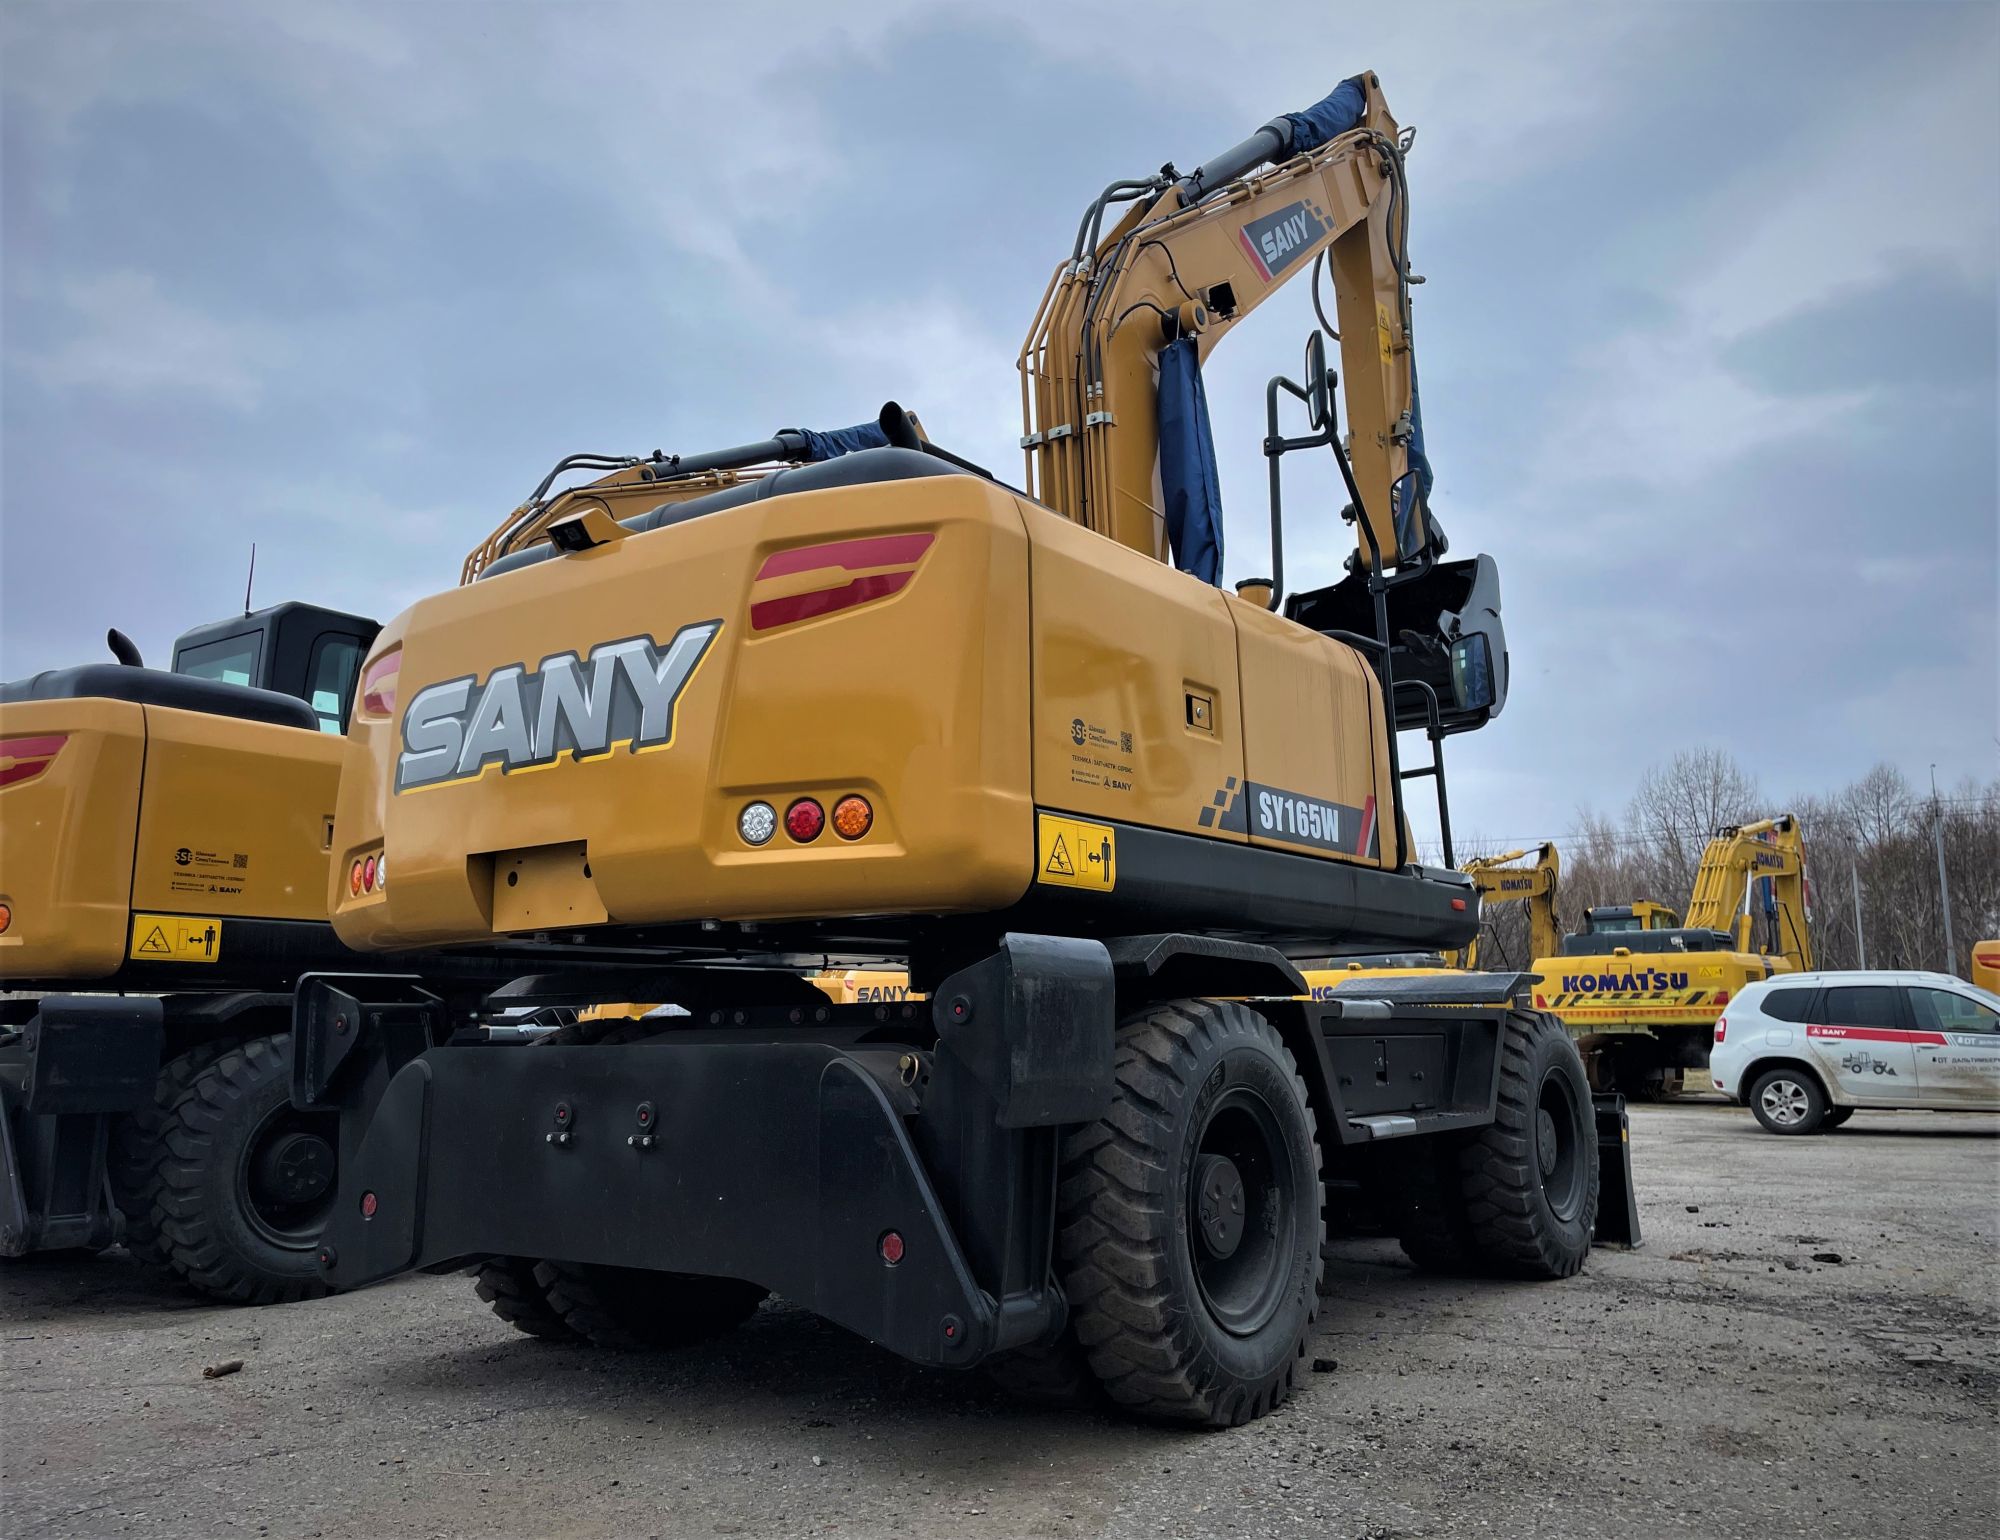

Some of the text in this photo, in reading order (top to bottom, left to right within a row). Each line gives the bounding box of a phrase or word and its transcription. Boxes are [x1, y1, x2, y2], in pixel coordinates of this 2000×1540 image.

[1261, 210, 1308, 264] SANY
[397, 620, 720, 790] SANY
[1072, 755, 1091, 764] ТЕХНИКА
[1112, 780, 1132, 791] SANY
[1259, 791, 1339, 843] SY165W
[1756, 850, 1784, 869] KOMATSU
[1501, 875, 1533, 891] KOMATSU
[1562, 968, 1688, 993] KOMATSU
[857, 985, 910, 1004] SANY
[1822, 1029, 1847, 1037] SANY
